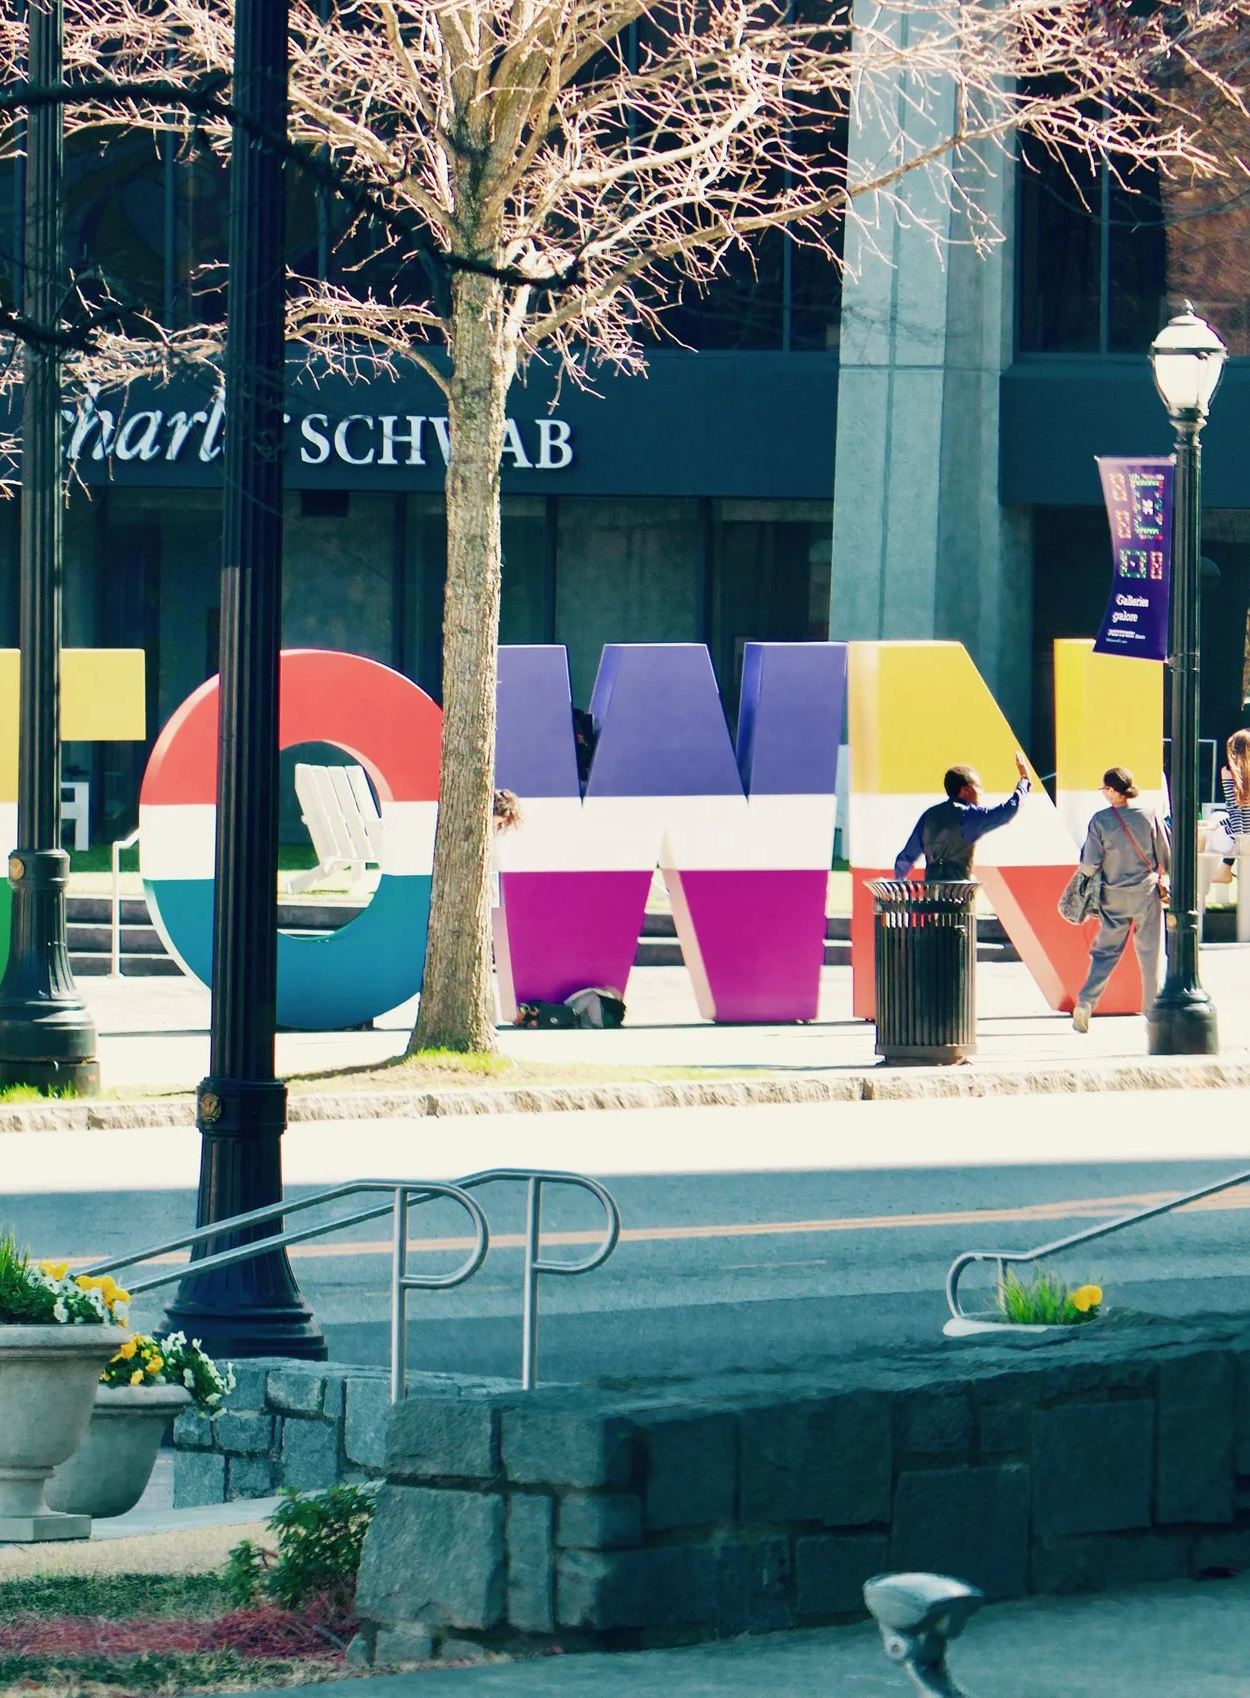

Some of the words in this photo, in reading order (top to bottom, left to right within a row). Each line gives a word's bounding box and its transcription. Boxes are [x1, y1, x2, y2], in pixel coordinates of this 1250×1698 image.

[59, 383, 291, 463] harl
[1115, 593, 1149, 608] Galleries
[1112, 609, 1139, 623] galore
